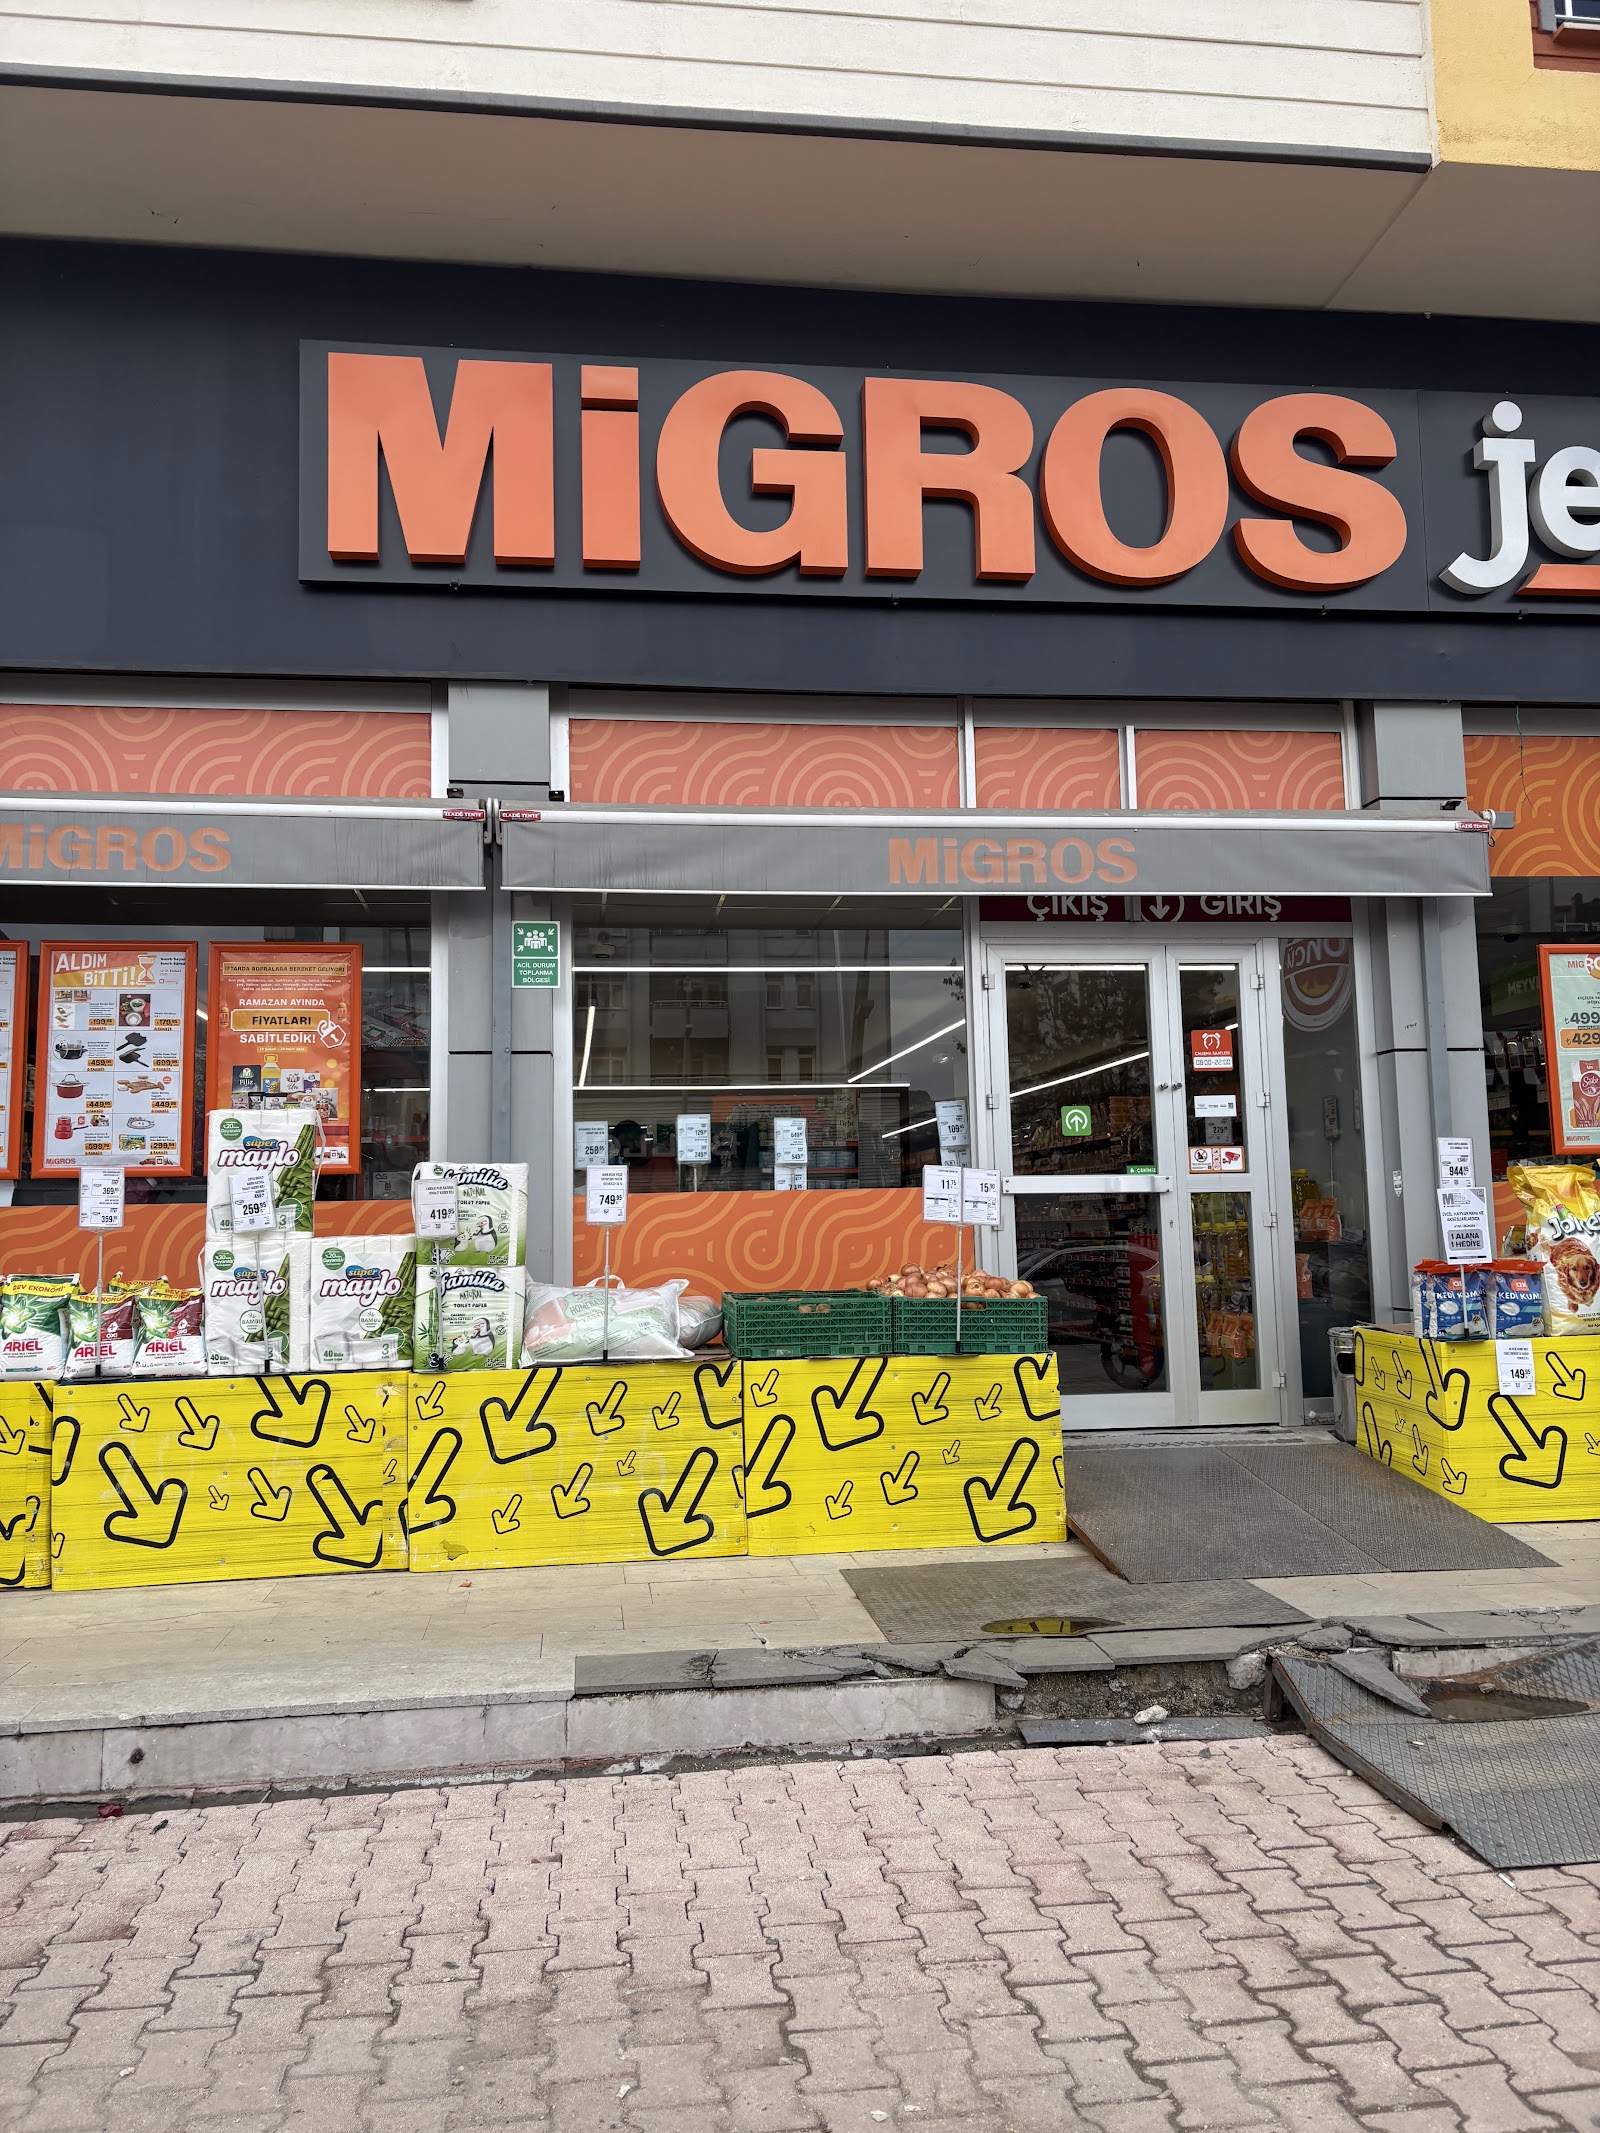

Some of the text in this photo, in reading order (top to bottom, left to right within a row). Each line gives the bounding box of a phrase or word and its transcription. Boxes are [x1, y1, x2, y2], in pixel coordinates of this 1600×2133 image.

[55, 953, 106, 972] ALDIM
[239, 998, 325, 1006] RAMAZAN AYINDA
[240, 1031, 317, 1044] SABİTLEDİK!
[217, 1141, 301, 1176] maylo
[1456, 1232, 1480, 1240] ALANA
[348, 1268, 378, 1277] süper
[210, 1270, 288, 1306] maylo
[320, 1269, 402, 1307] maylo
[440, 1270, 504, 1297] familia
[3, 1341, 43, 1352] ARIEL
[145, 1340, 187, 1353] ARIEL
[382, 1343, 390, 1355] 3
